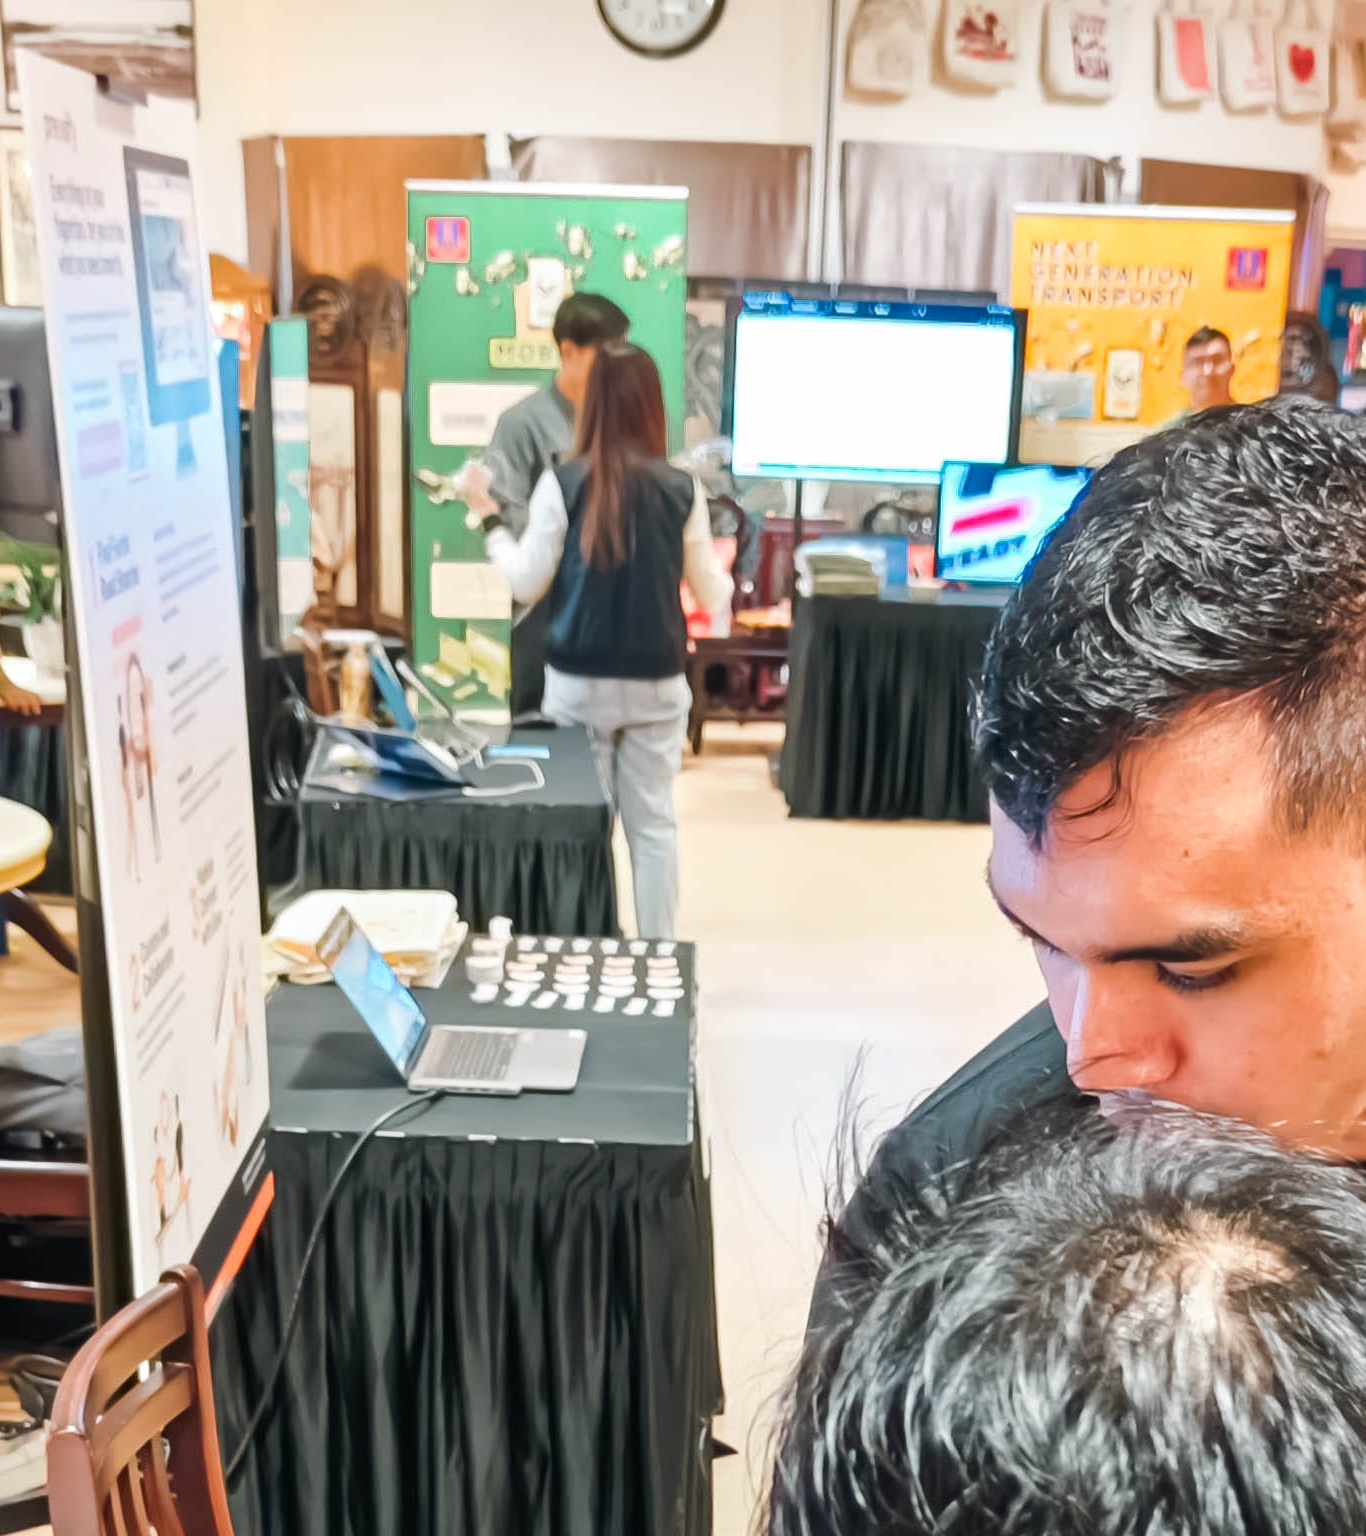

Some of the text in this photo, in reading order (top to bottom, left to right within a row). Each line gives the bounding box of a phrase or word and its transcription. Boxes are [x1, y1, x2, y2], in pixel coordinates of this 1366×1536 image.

[1032, 241, 1097, 261] NEXT
[1031, 262, 1195, 287] GENERATION
[1032, 285, 1184, 307] TRANSPORT
